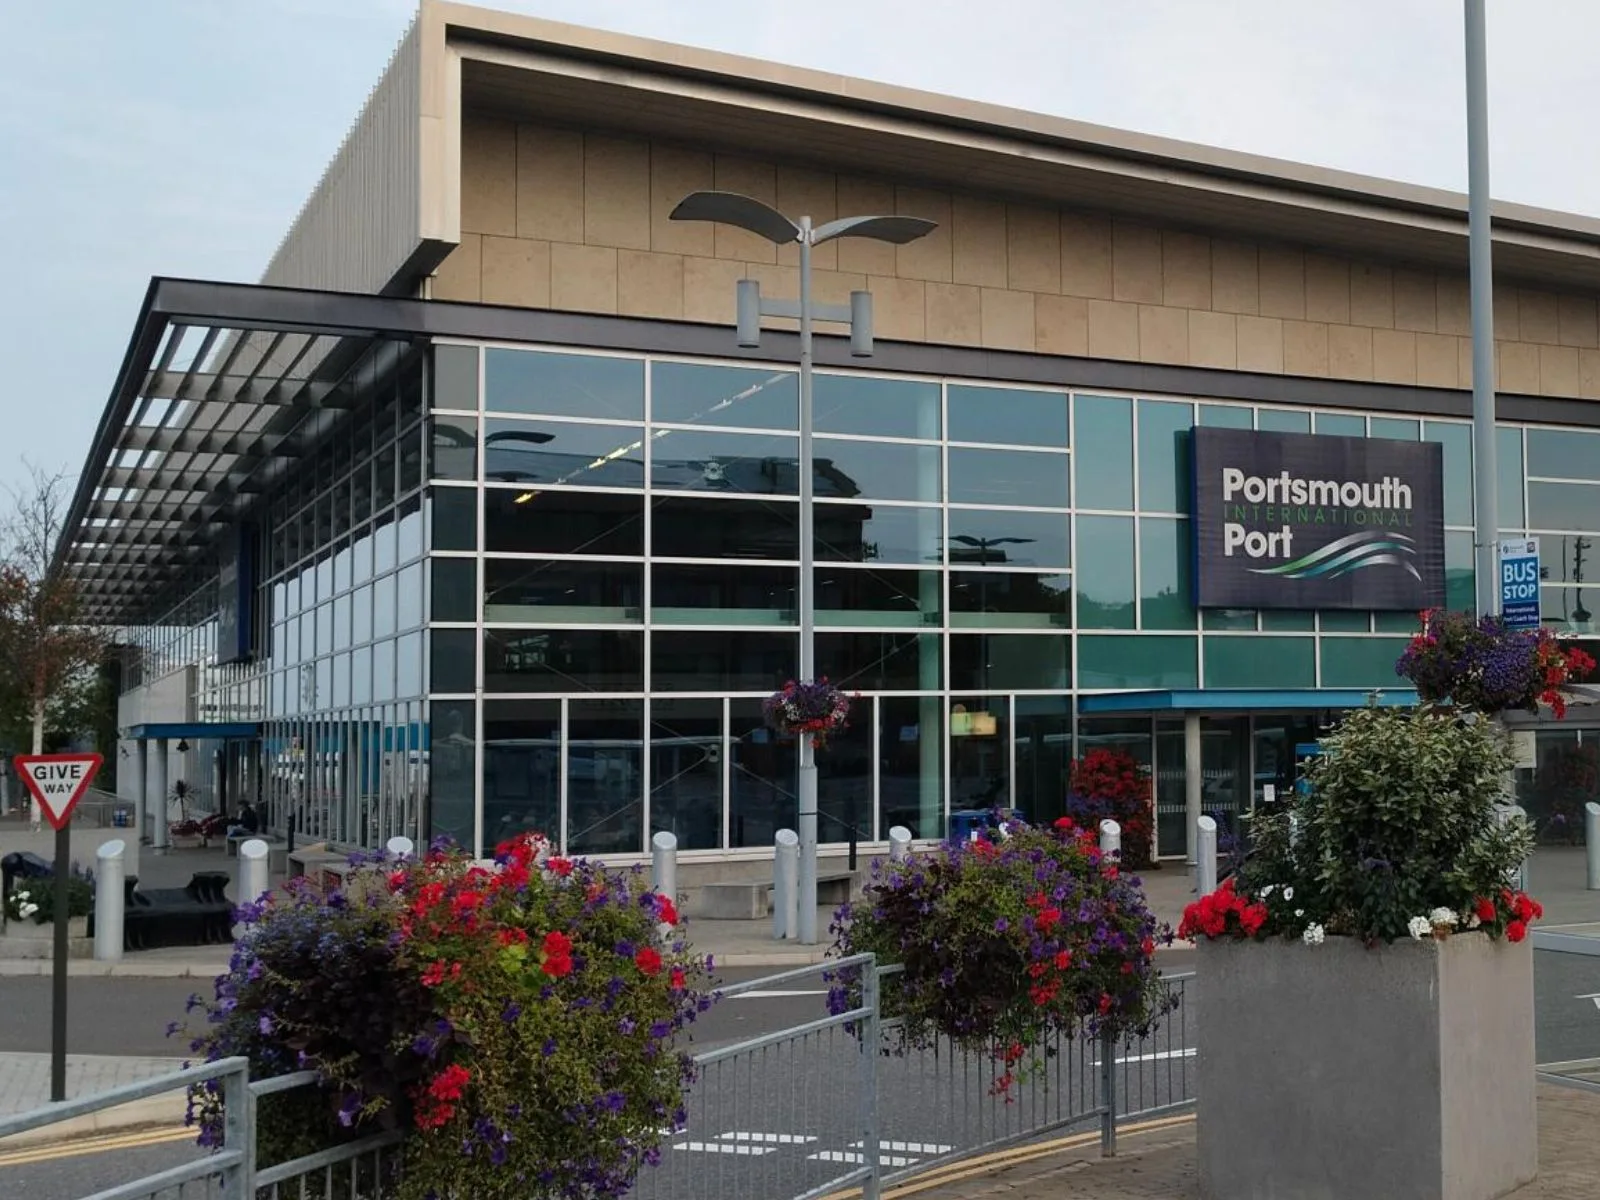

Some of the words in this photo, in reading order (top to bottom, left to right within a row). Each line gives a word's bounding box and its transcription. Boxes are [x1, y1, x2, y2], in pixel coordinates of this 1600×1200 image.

[1223, 468, 1412, 508] Portsmouth
[1224, 504, 1412, 527] INTERNATIONAL
[1224, 523, 1293, 557] Port
[1503, 562, 1535, 582] BUS
[1503, 584, 1536, 599] STOP
[34, 765, 81, 779] GIVE
[44, 784, 73, 793] WAY
